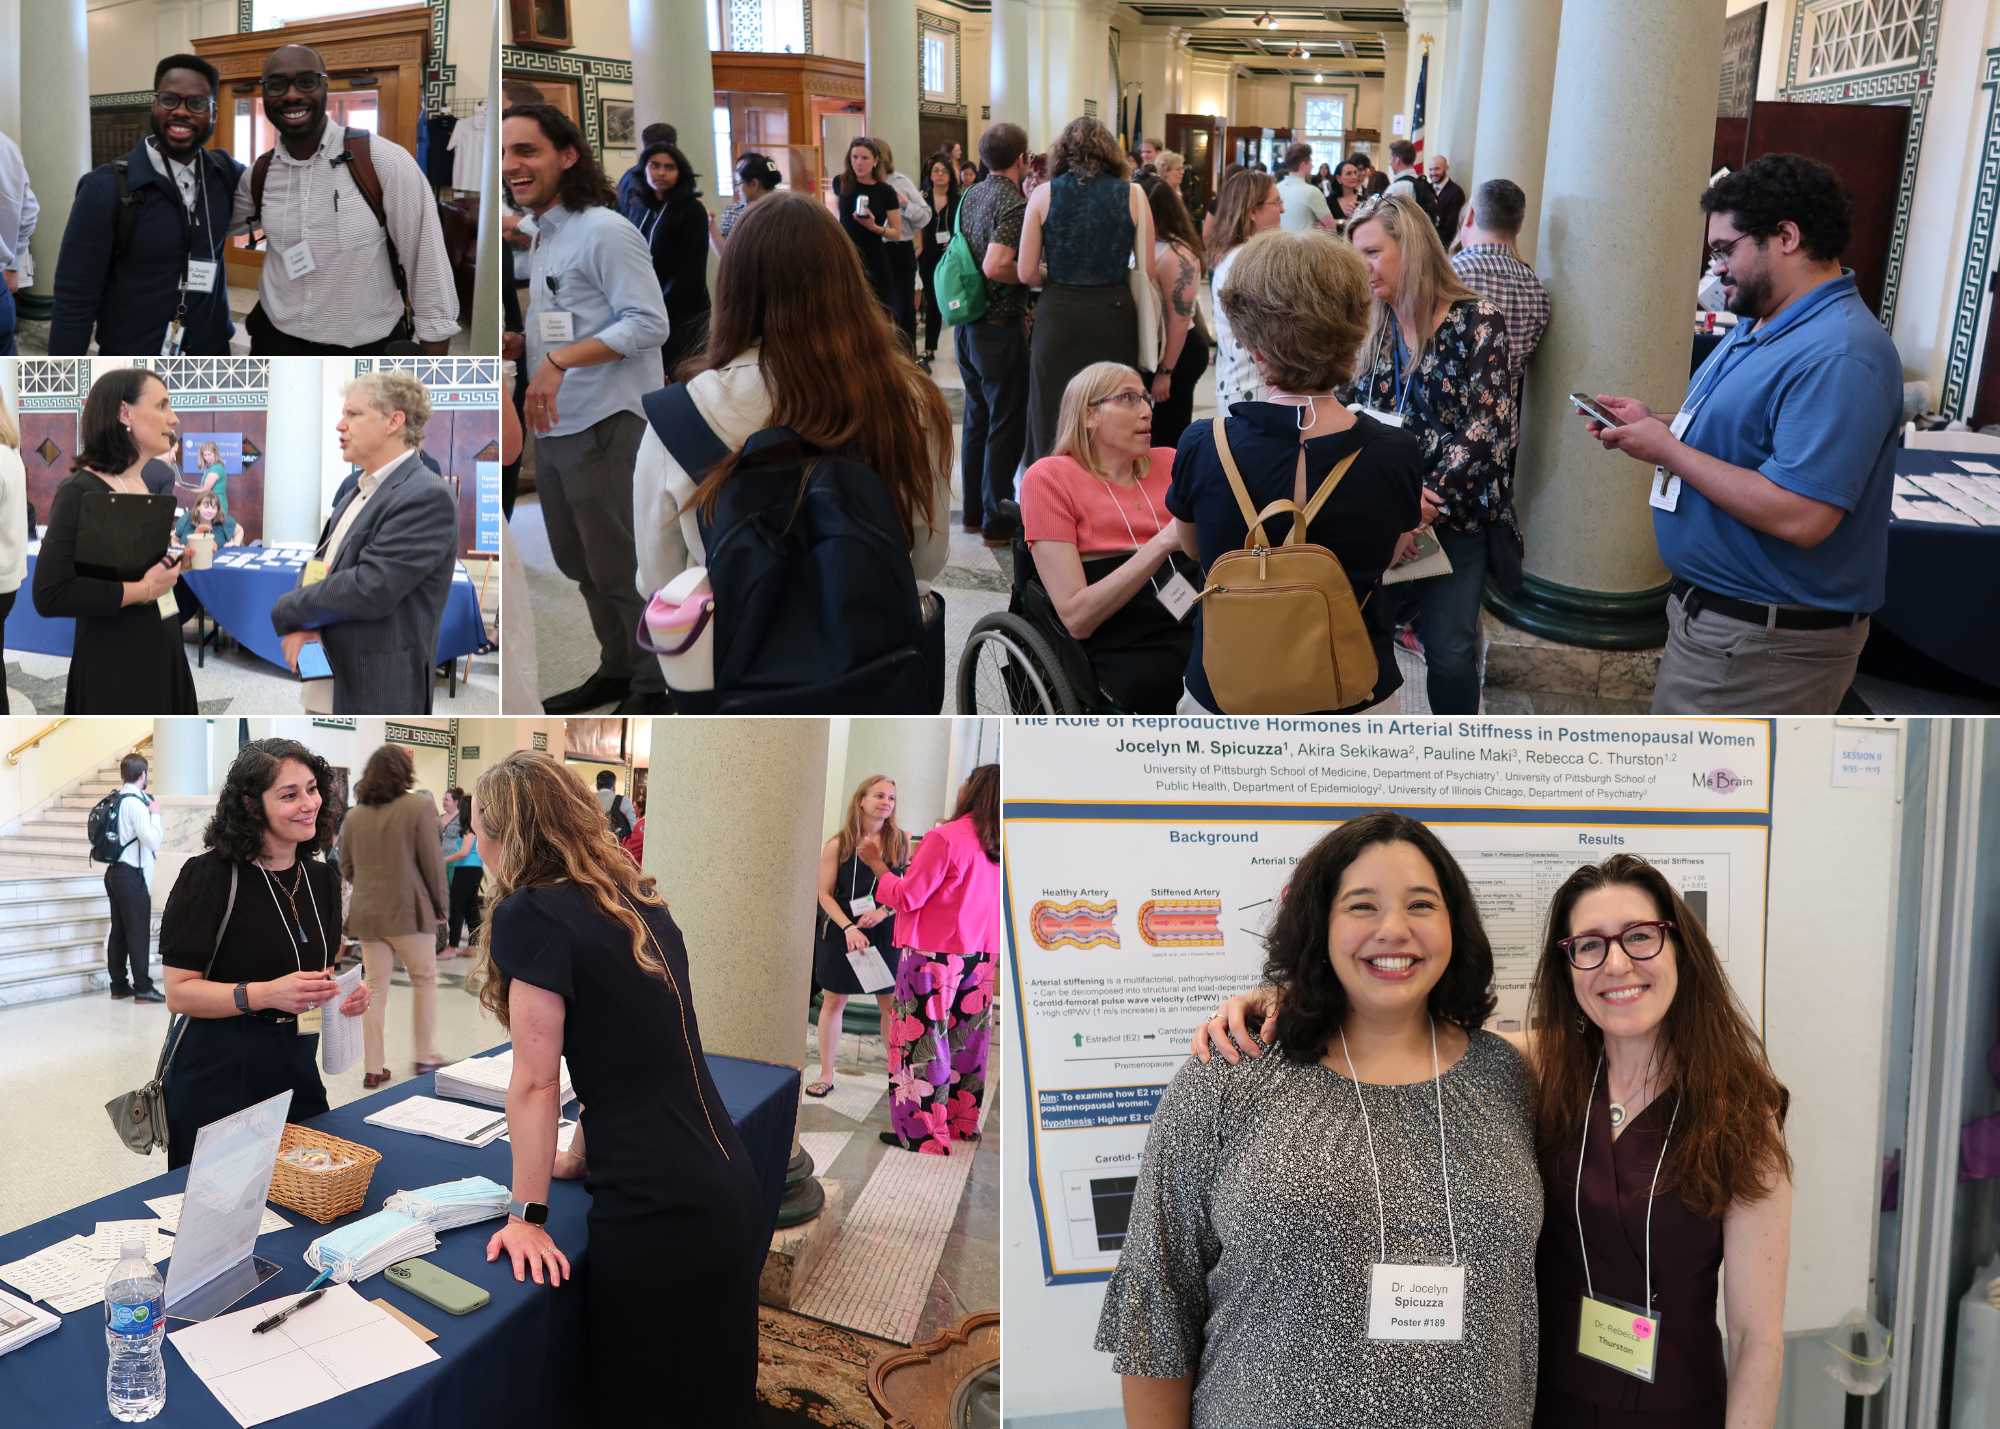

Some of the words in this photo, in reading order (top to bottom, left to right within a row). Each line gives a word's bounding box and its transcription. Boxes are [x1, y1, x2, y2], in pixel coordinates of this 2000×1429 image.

[1132, 717, 1260, 731] Reproductive
[1266, 717, 1361, 733] Hormones
[1368, 718, 1384, 734] in
[1389, 719, 1452, 737] Arterial
[1458, 722, 1533, 740] Stiffness
[1538, 726, 1552, 741] in
[1558, 727, 1693, 746] Postmenopausal
[1699, 731, 1755, 747] Women
[1116, 739, 1181, 756] Jocelyn
[1186, 740, 1205, 754] M.
[1298, 743, 1335, 757] Akira
[1424, 746, 1476, 761] Pauline
[1526, 751, 1584, 765] Rebecca
[1588, 752, 1603, 765] C.
[1842, 751, 1876, 761] SESSION
[1143, 764, 1197, 776] University
[1200, 764, 1211, 775] of
[1213, 765, 1266, 777] Pittsburgh
[1270, 766, 1306, 777] School
[1309, 767, 1319, 777] of
[1321, 767, 1370, 779] Medicine,
[1373, 768, 1431, 781] Department
[1434, 769, 1444, 779] of
[1505, 772, 1551, 784] University
[1553, 773, 1563, 783] of
[1565, 773, 1612, 786] Pittsburgh
[1615, 774, 1645, 784] School
[1647, 774, 1657, 784] of
[1716, 771, 1753, 789] Brain
[1156, 780, 1189, 792] Public
[1192, 780, 1230, 793] Health,
[1233, 781, 1294, 795] Department
[1297, 783, 1307, 793] of
[1388, 784, 1437, 797] University
[1440, 785, 1449, 795] of
[1452, 785, 1482, 796] Illinois
[1485, 786, 1526, 798] Chicago,
[1529, 787, 1583, 799] Department
[1585, 788, 1595, 798] of
[1170, 830, 1259, 845] Background
[1578, 833, 1625, 845] Results
[1251, 856, 1286, 866] Arterial
[1671, 857, 1705, 865] Stiffness
[1042, 888, 1077, 898] Healthy
[1080, 888, 1109, 898] Artery
[1151, 888, 1192, 897] Stiffened
[1194, 888, 1220, 898] Artery
[1031, 979, 1061, 987] Arterial
[1063, 977, 1105, 987] stiffening
[1178, 974, 1249, 985] pathophysiological
[1040, 989, 1058, 997] Can
[1060, 988, 1069, 996] be
[1071, 987, 1124, 997] decomposed
[1126, 986, 1141, 995] into
[1143, 985, 1179, 994] structural
[1181, 984, 1197, 993] and
[1033, 998, 1100, 1007] Carotid-femoral
[1101, 997, 1124, 1006] pulse
[1127, 997, 1149, 1005] wave
[1151, 995, 1184, 1005] velocity
[1042, 1009, 1062, 1018] High
[1085, 1034, 1121, 1043] Estradiol
[1122, 1033, 1141, 1043] (E2)
[1114, 1061, 1174, 1070] Premenopause
[1040, 1093, 1060, 1103] Aim:
[1062, 1092, 1073, 1101] To
[1075, 1092, 1114, 1101] examine
[1116, 1090, 1135, 1099] how
[1137, 1088, 1149, 1097] E2
[1041, 1101, 1115, 1113] postmenopausal
[1117, 1100, 1152, 1109] women.
[1042, 1117, 1095, 1128] Hypothesis:
[1098, 1115, 1127, 1124] Higher
[1129, 1113, 1142, 1123] E2
[1410, 1283, 1448, 1296] Jocelyn
[1394, 1296, 1444, 1309] Spicuzza
[1391, 1317, 1421, 1327] Poster
[1423, 1318, 1445, 1327] #189
[1598, 1335, 1634, 1355] Thurston
